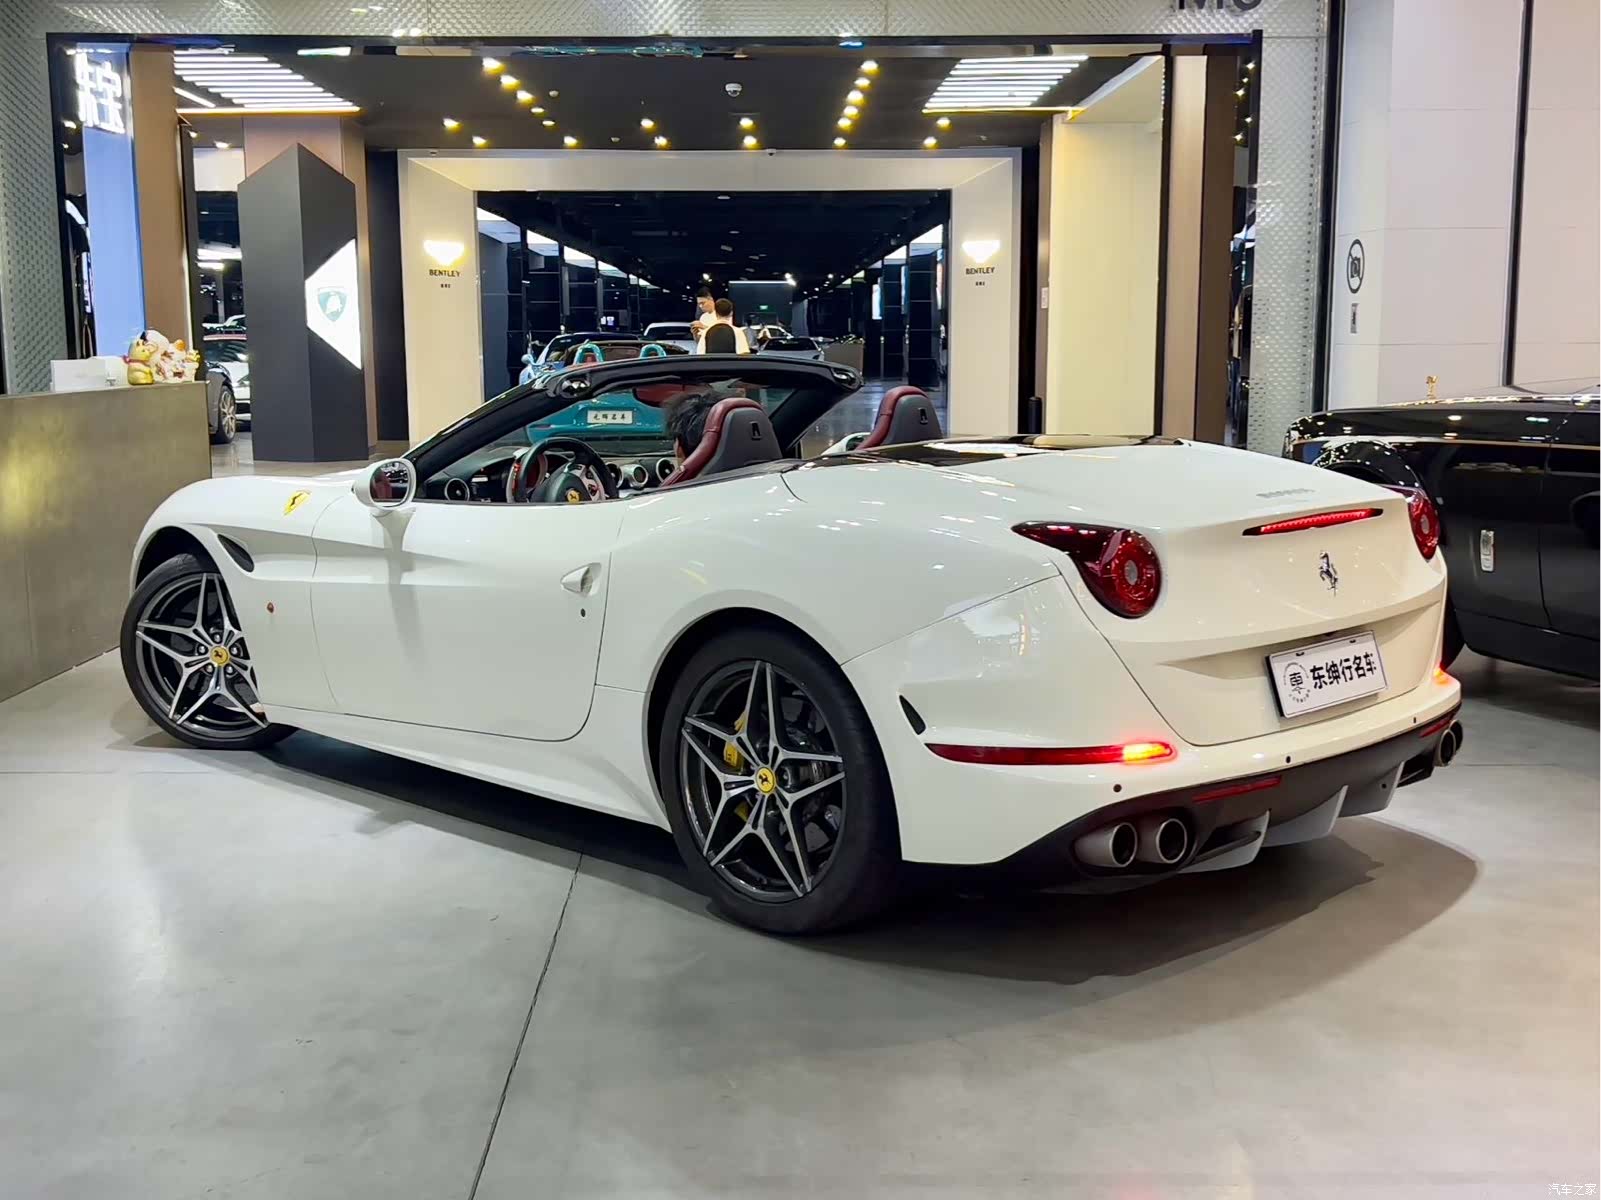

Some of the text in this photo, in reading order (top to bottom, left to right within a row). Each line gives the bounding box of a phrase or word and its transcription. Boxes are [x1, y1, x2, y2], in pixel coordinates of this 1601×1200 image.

[429, 269, 460, 277] BENTLEY
[966, 267, 995, 275] BENTLEY
[1310, 652, 1377, 689] 东绅行名车
